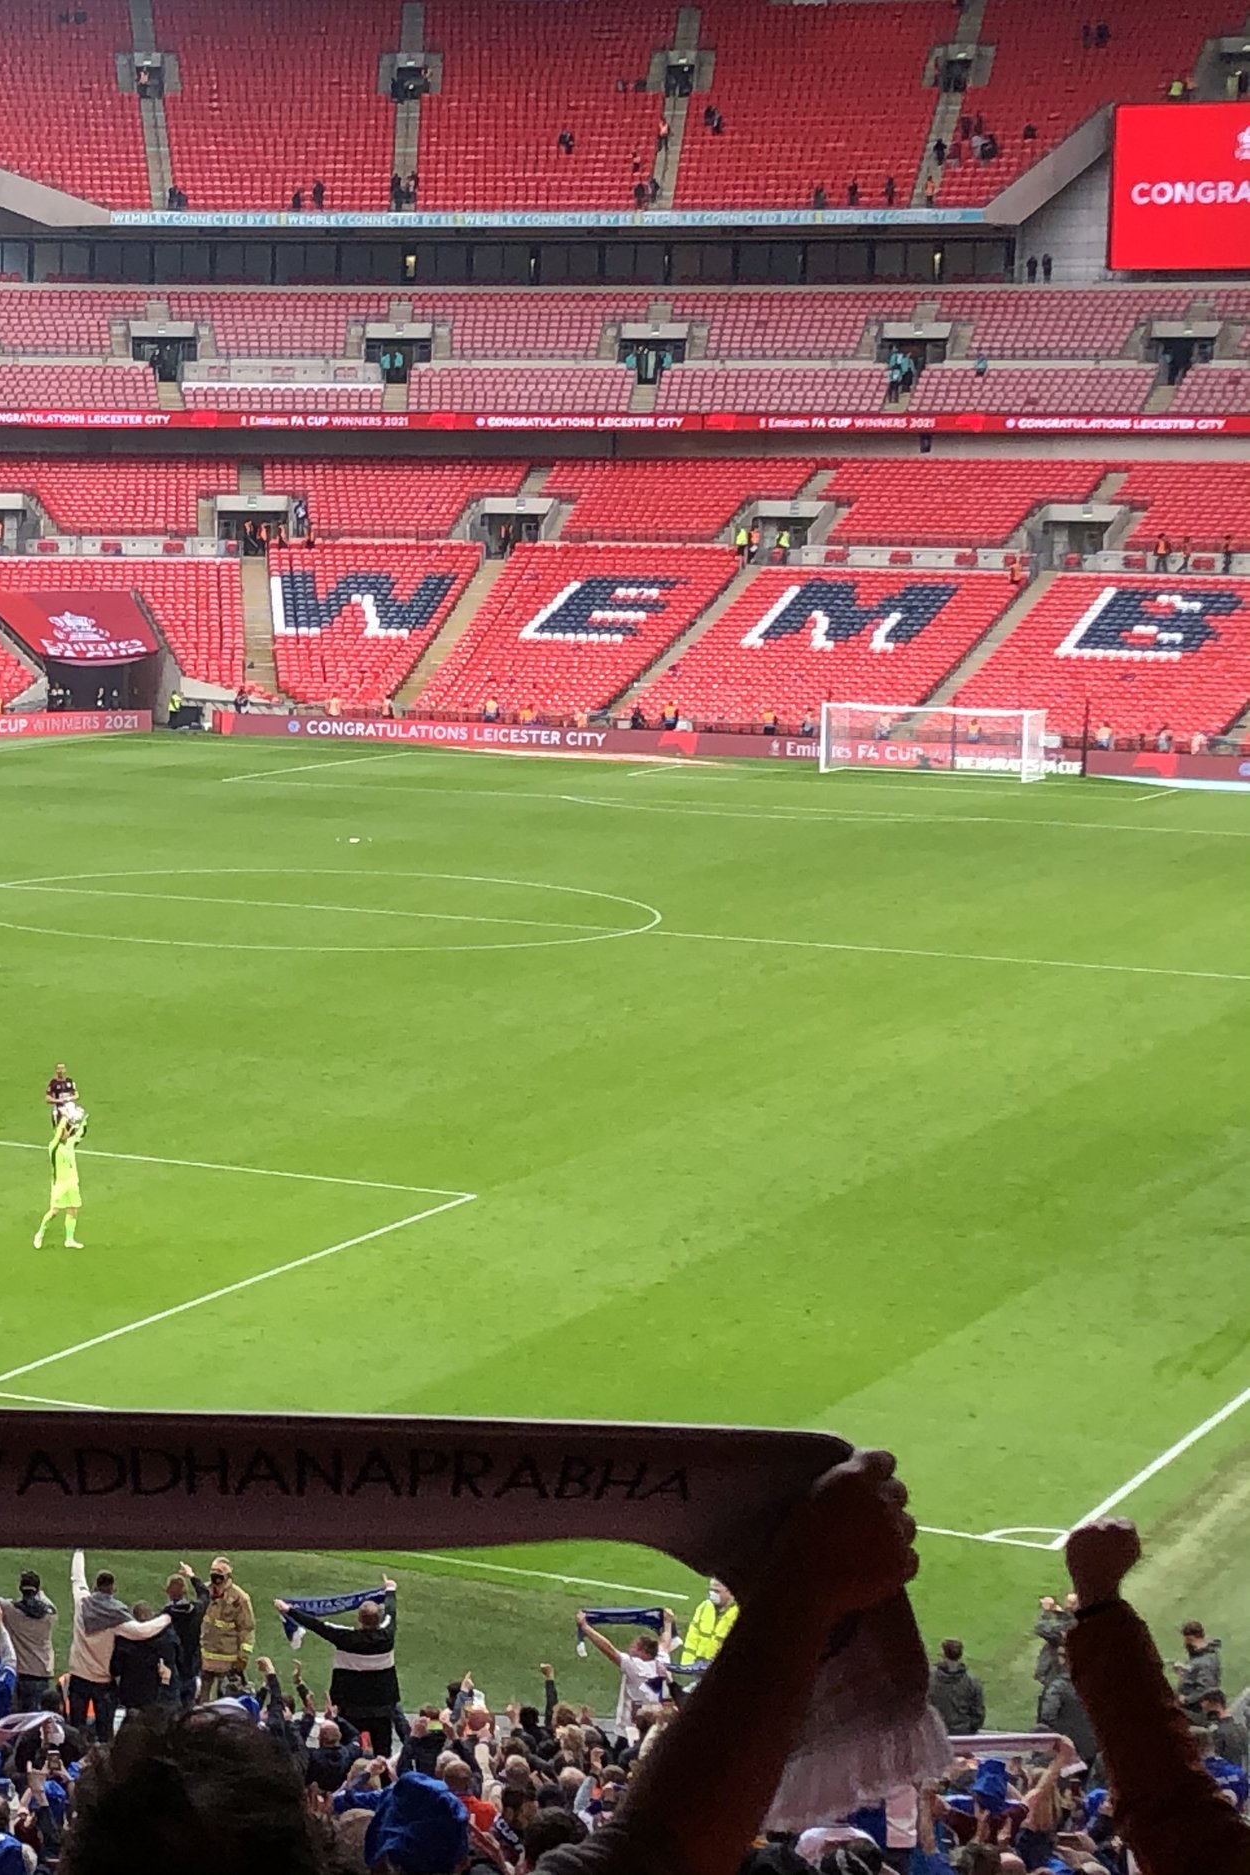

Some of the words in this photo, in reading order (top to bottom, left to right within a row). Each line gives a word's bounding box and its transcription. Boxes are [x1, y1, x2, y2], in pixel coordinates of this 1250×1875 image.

[114, 214, 171, 224] WEMBLEY
[172, 214, 243, 224] CONNECTED
[247, 214, 262, 224] BY
[88, 414, 142, 424] LEICESTER
[144, 414, 170, 424] CITY
[291, 416, 304, 426] FA
[306, 416, 329, 426] CUP
[384, 416, 408, 426] 2021
[487, 417, 594, 427] CONGRATULATIONS
[597, 417, 654, 427] LEICESTER
[657, 417, 684, 427] CITY
[811, 418, 825, 428] FA
[828, 418, 851, 428] CUP
[910, 418, 936, 428] 2021
[1017, 418, 1132, 428] CONGRATULATIONS
[1133, 418, 1194, 428] LEICESTER
[1196, 418, 1226, 428] CITY
[40, 639, 143, 652] Emirates
[32, 714, 100, 731] WINNERS
[104, 713, 138, 729] 2021
[306, 720, 469, 742] CONGRATULATIONS
[473, 726, 560, 746] LEICESTER
[565, 730, 607, 749] CITY
[786, 741, 852, 759] Emirtes
[857, 744, 880, 760] FA
